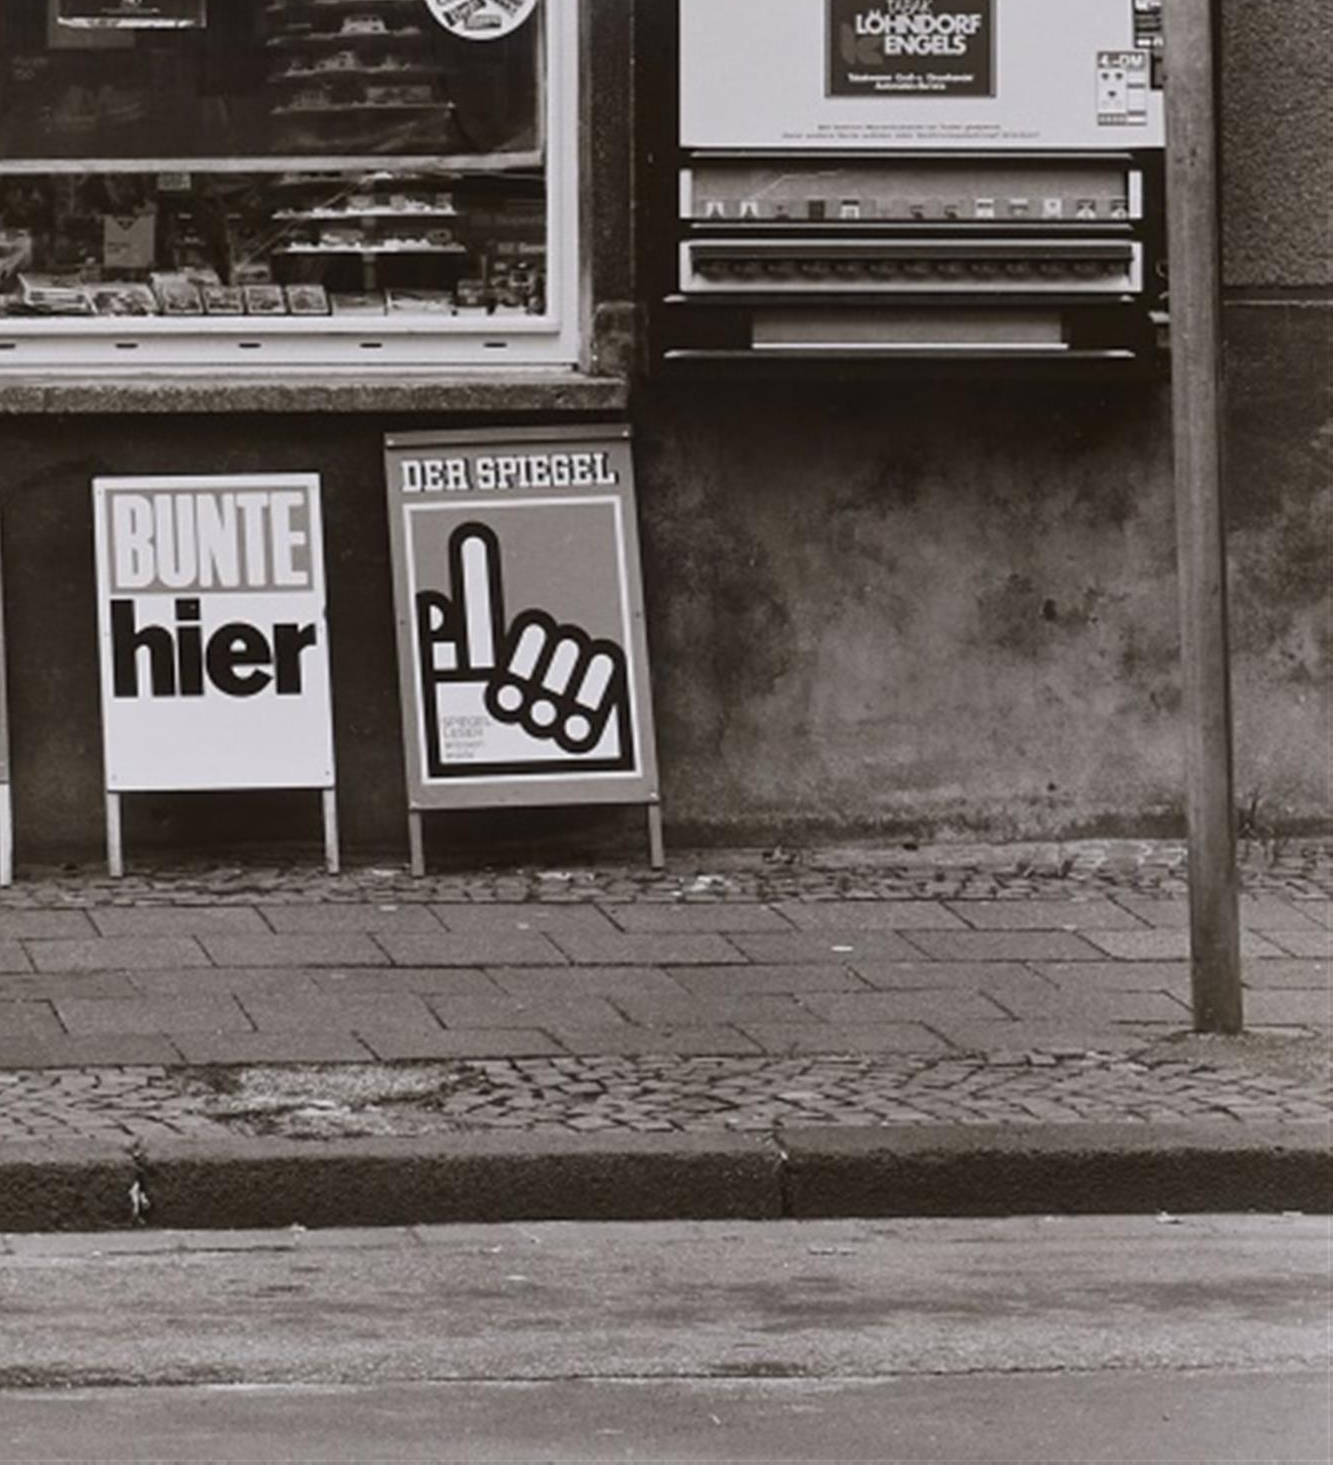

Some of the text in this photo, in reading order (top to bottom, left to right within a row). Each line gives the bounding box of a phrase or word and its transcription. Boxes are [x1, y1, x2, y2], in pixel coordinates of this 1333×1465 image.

[855, 9, 983, 35] LÖHNDORF
[884, 35, 968, 56] ENGELS
[400, 452, 619, 493] DER SPIEGEL
[111, 490, 310, 590] BUNTE
[109, 596, 318, 699] hier
